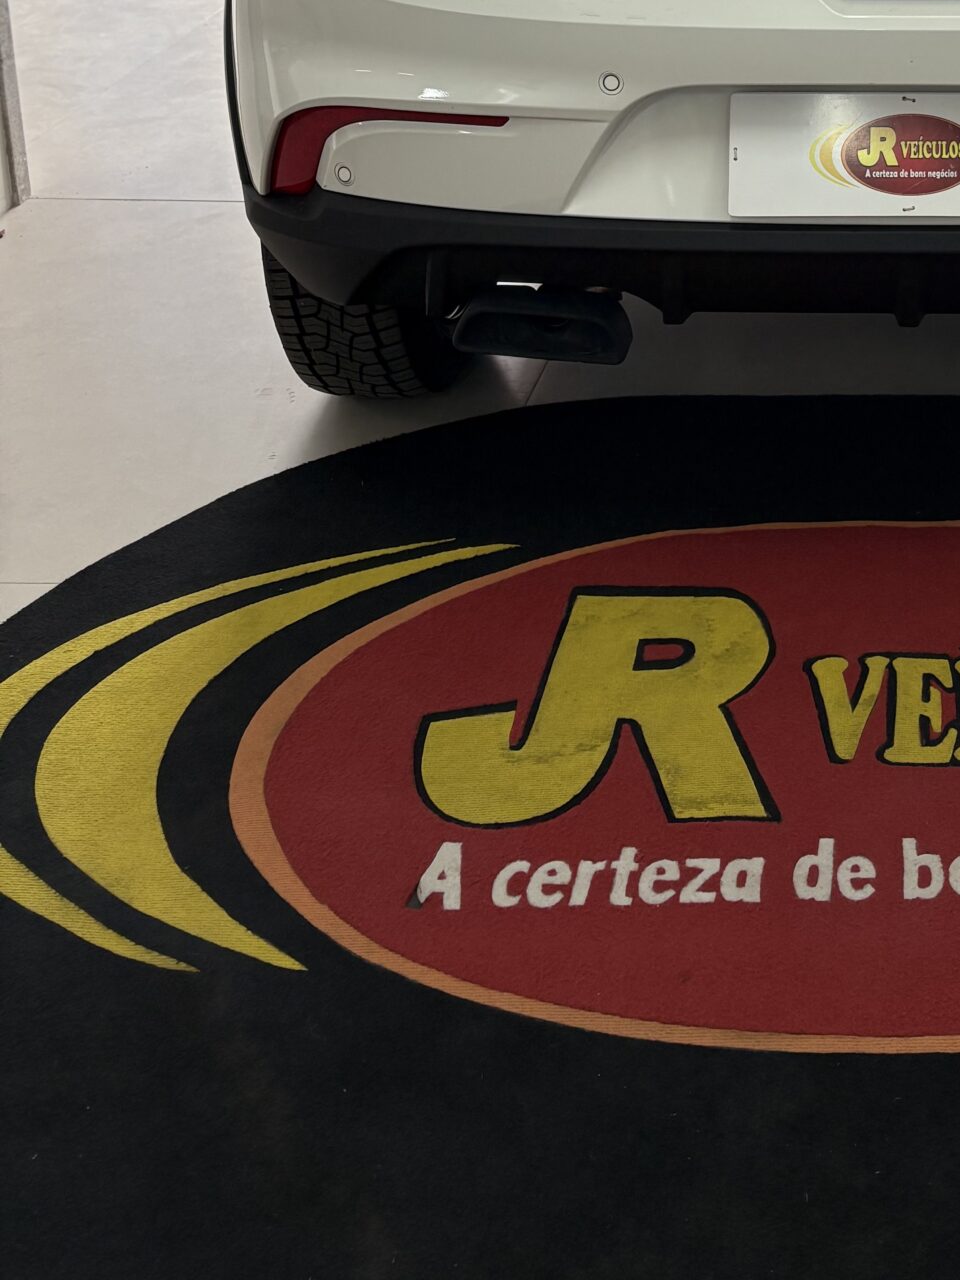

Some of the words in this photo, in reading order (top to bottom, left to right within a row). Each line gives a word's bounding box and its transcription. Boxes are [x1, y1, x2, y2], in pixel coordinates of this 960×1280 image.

[856, 125, 899, 167] JR
[865, 168, 871, 178] A
[872, 170, 898, 178] certeza
[899, 169, 909, 178] de
[910, 169, 926, 178] bons
[928, 169, 957, 180] negócios
[414, 587, 781, 827] JR
[410, 841, 463, 910] A
[490, 846, 766, 908] certeza
[792, 837, 877, 902] de
